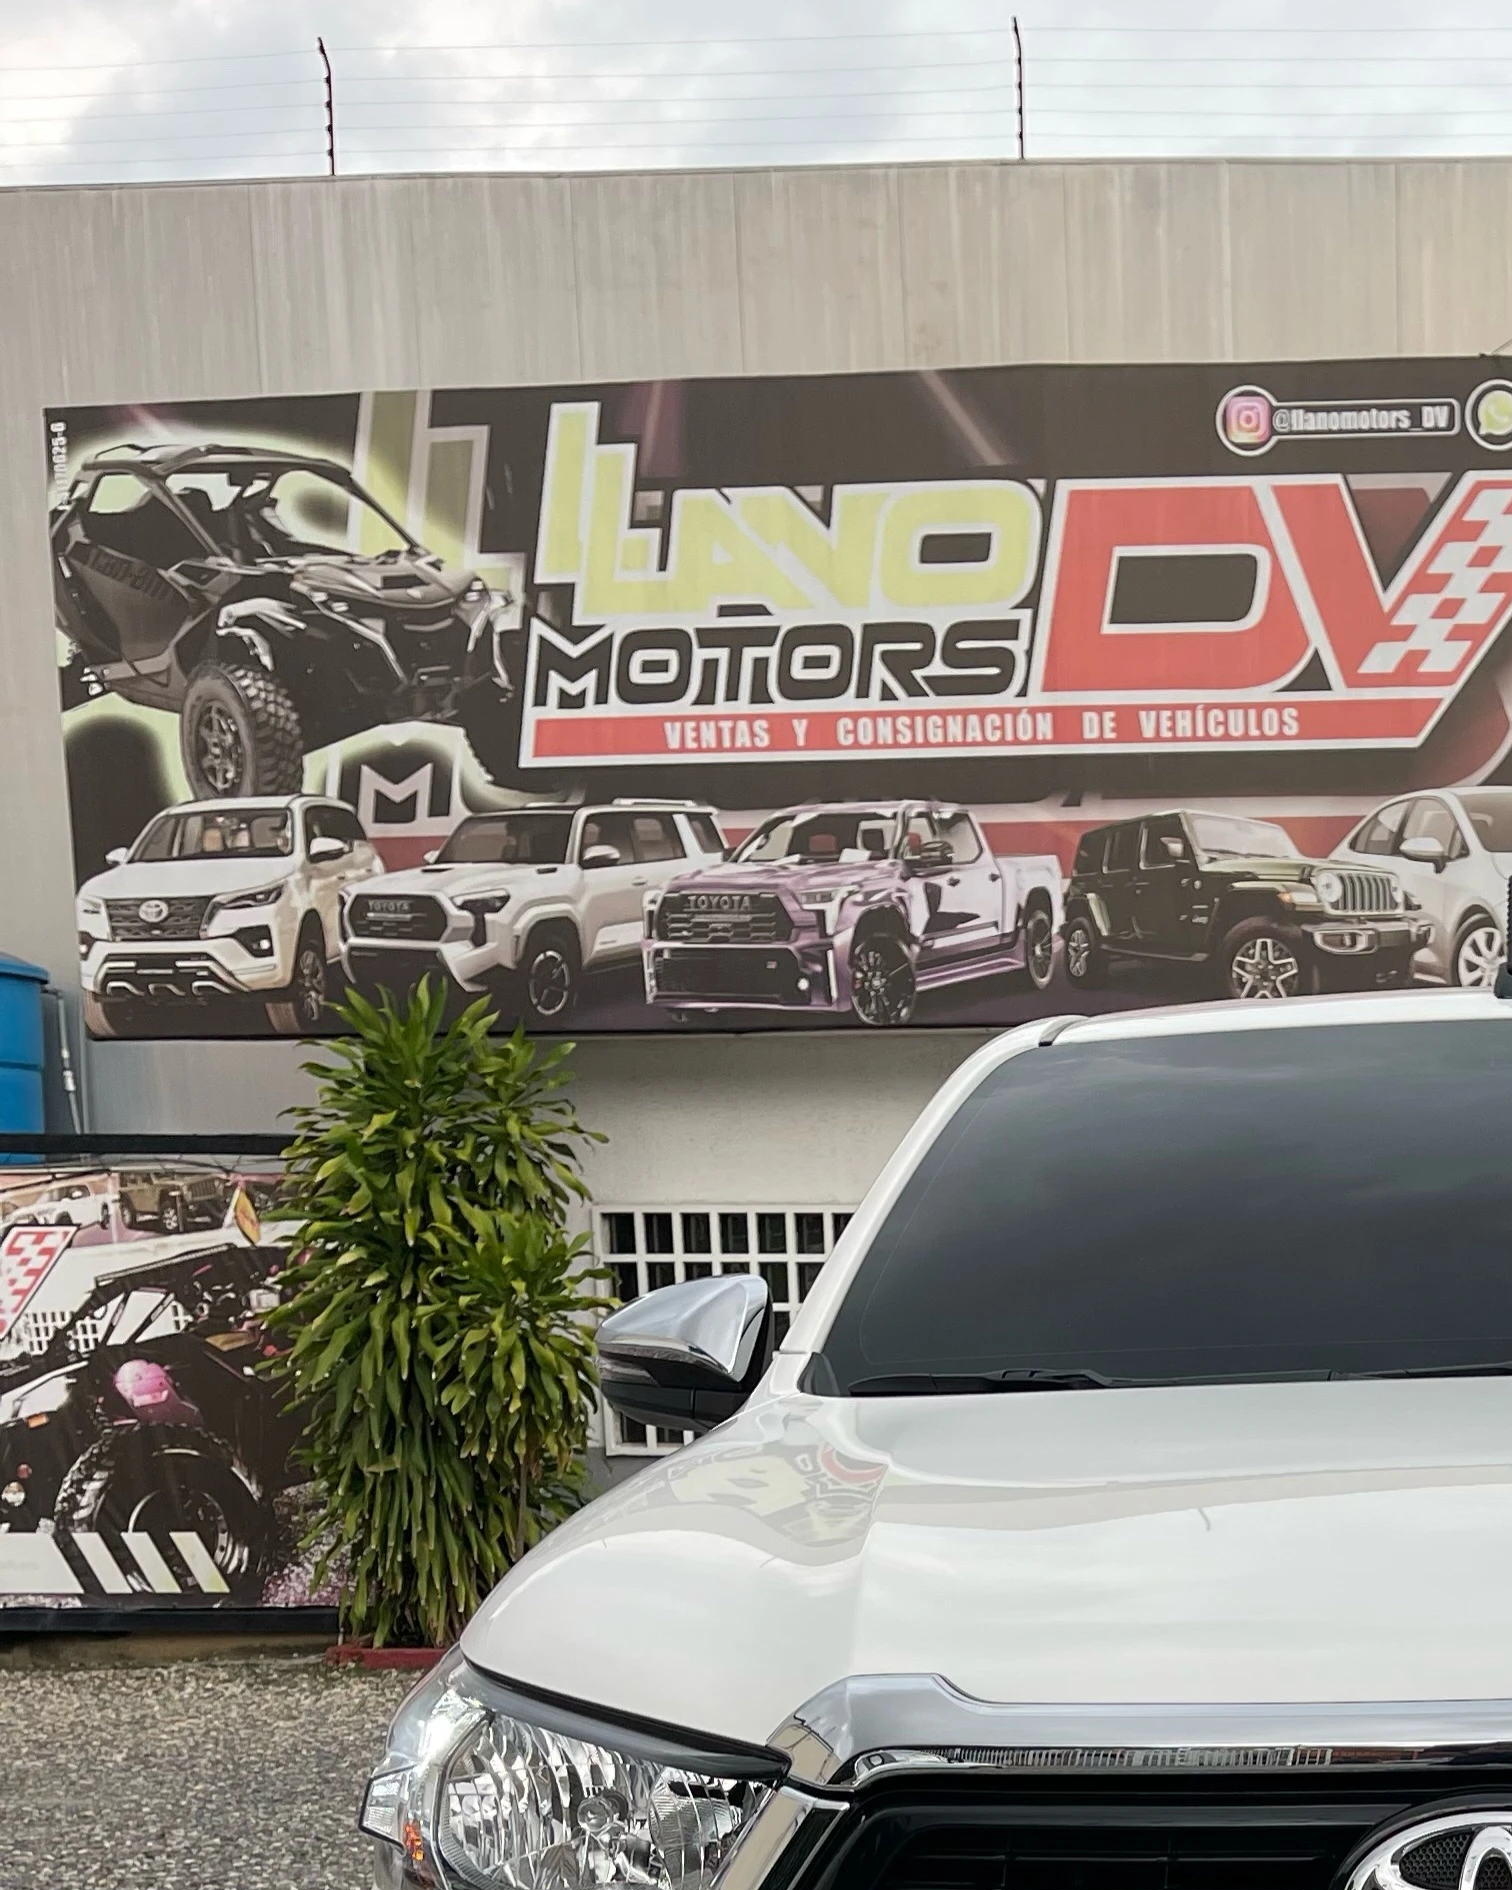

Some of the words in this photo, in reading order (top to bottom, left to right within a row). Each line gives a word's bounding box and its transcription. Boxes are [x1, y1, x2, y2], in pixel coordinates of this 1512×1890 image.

[1272, 405, 1450, 432] @llanomotors_DV
[535, 401, 1041, 621] LLANO
[530, 618, 1030, 709] MOTORS
[664, 720, 770, 749] VENTAS
[792, 718, 809, 747] Y
[836, 709, 1054, 746] CONSIGNACIÓN
[1082, 710, 1117, 740] DE
[1138, 706, 1299, 739] VEHÍCULOS
